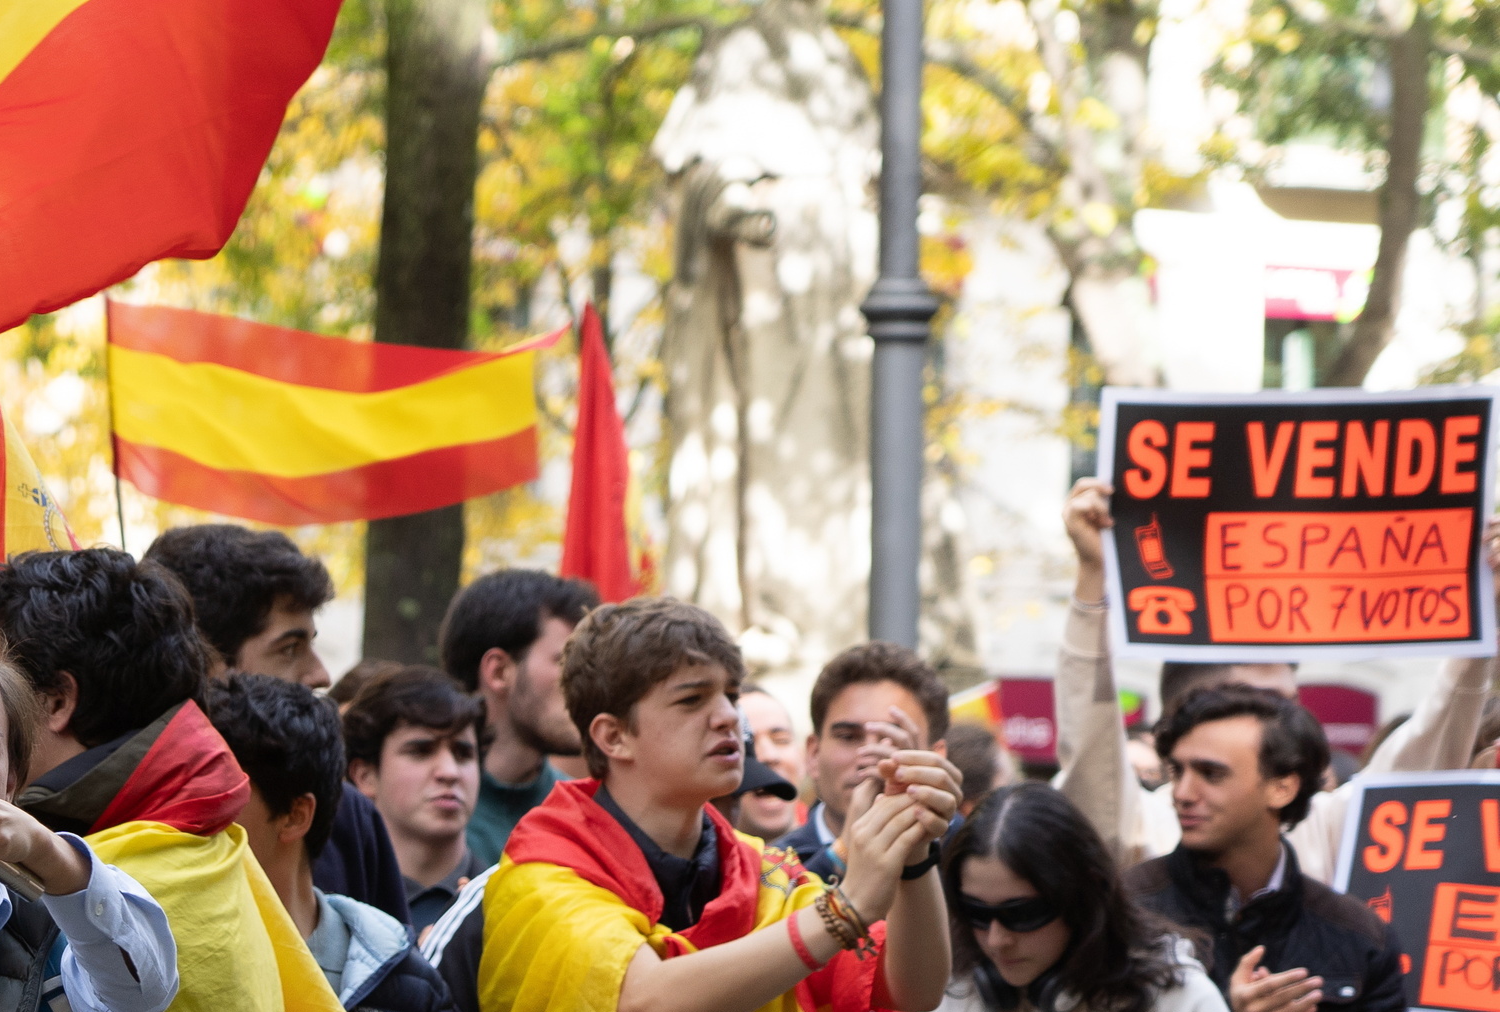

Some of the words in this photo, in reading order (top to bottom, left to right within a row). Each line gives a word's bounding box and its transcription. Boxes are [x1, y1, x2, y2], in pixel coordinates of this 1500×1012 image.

[1123, 419, 1216, 500] SE
[1245, 415, 1481, 498] VENDE
[1219, 516, 1448, 571] ESPAÑA
[1223, 584, 1312, 633] POR
[1329, 586, 1354, 631] 7
[1359, 584, 1462, 632] VOTOS
[1363, 799, 1452, 873] SE
